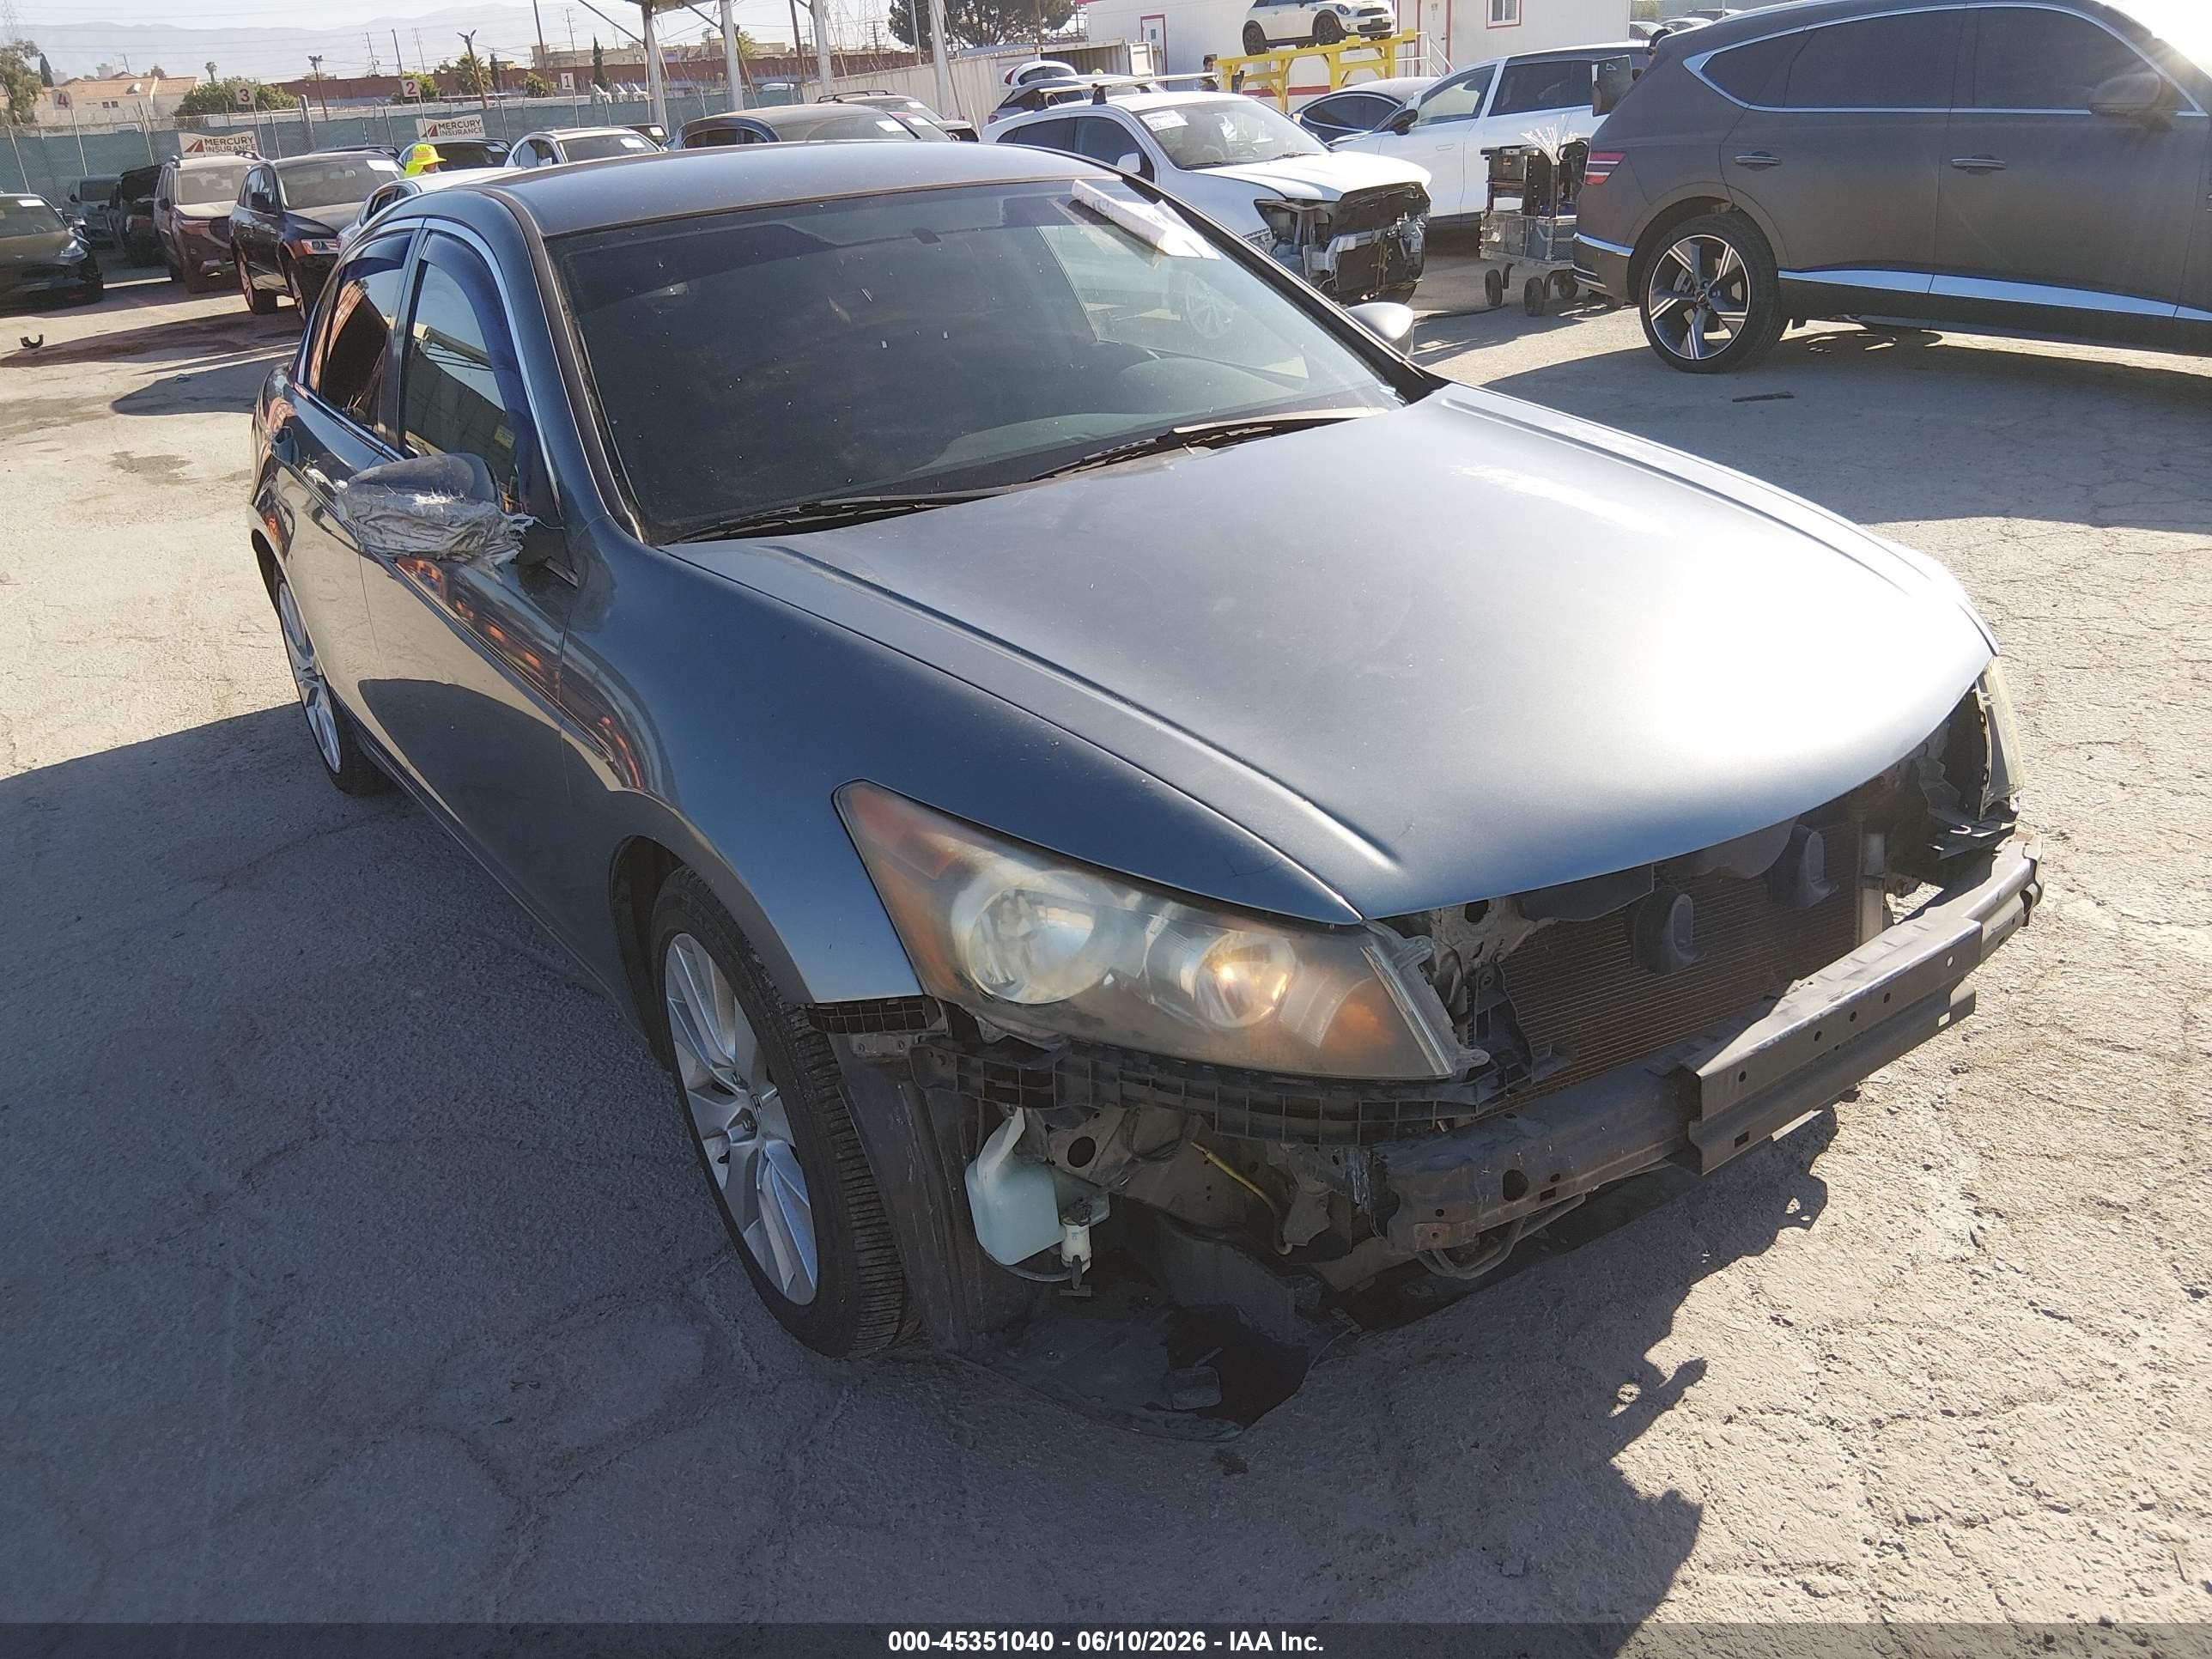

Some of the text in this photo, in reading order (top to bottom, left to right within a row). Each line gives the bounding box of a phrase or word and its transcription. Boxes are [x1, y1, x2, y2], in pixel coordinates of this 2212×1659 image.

[564, 75, 571, 88] 1
[405, 82, 416, 94] 2
[58, 94, 69, 107] 4
[240, 88, 250, 102] 3
[438, 119, 481, 130] MERCURY
[440, 127, 483, 137] INSURANCE
[204, 136, 253, 146] MERCURY
[205, 143, 257, 153] INSURANCE
